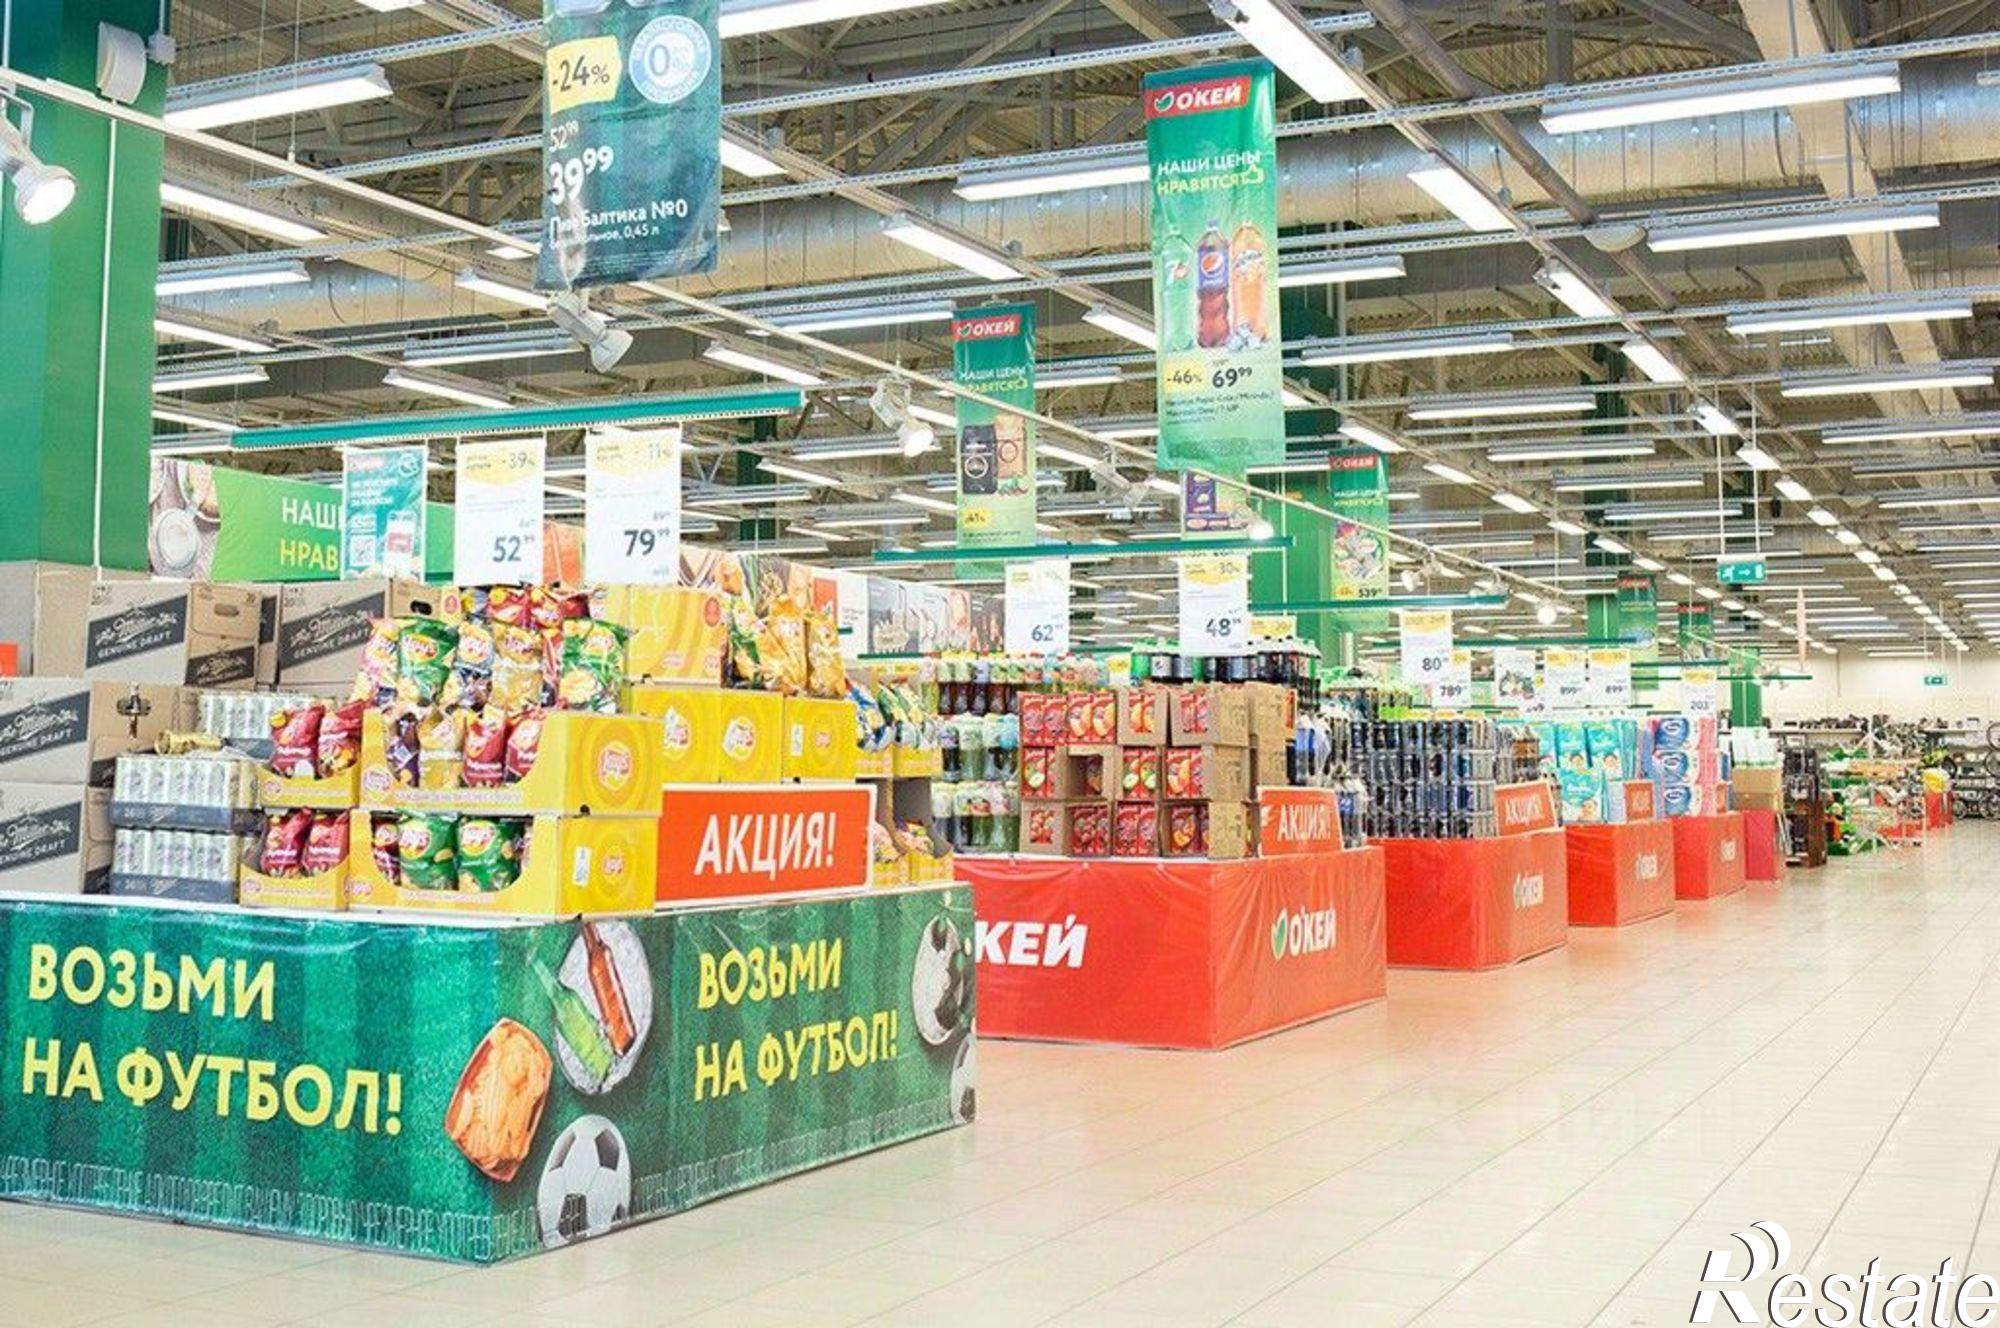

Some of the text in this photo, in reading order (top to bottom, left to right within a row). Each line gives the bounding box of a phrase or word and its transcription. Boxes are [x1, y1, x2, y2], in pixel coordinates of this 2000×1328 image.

[552, 55, 611, 92] -24%
[1176, 82, 1242, 110] О'КЕЙ
[1157, 151, 1261, 176] НАШИ ЦЕНЫ
[1157, 173, 1240, 195] НРАВЯТСЯ
[582, 207, 647, 226] Балтика
[281, 496, 344, 531] НАШ
[140, 630, 172, 647] DRAFT
[1277, 803, 1331, 847] АКЦИЯ!
[693, 812, 836, 881] АКЦИЯ!
[28, 943, 275, 1021] ВОЗЬМИ
[697, 937, 842, 1010] ВОЗЬМИ
[695, 1009, 897, 1101] НА ФУТБОЛ!
[22, 1037, 402, 1136] НА ФУТБОЛ!
